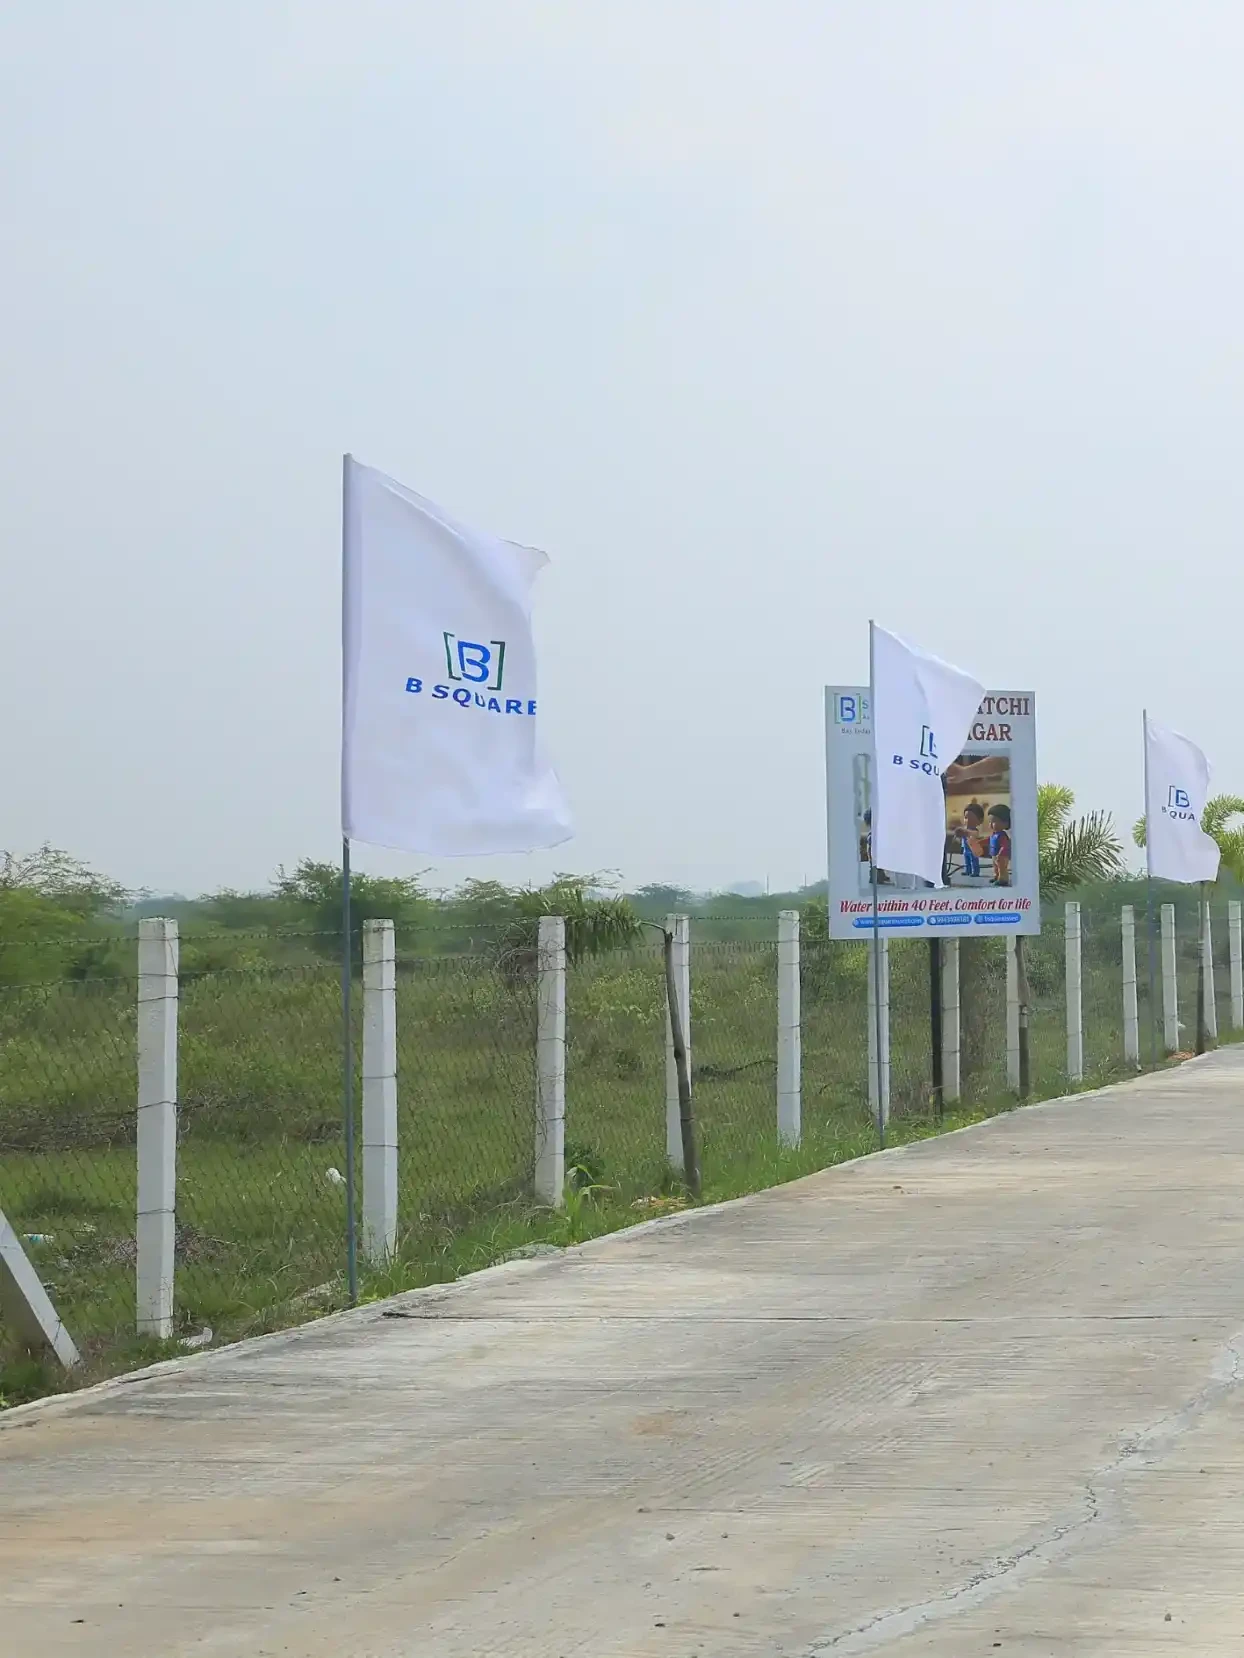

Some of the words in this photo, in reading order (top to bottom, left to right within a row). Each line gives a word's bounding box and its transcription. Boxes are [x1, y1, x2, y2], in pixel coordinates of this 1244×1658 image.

[405, 677, 423, 694] B
[431, 684, 537, 716] SQUARE
[967, 722, 1013, 742] GAR
[892, 754, 904, 766] B
[840, 900, 873, 913] Water
[911, 900, 927, 911] 40
[955, 898, 997, 911] Comfort
[998, 898, 1014, 910] for
[1015, 898, 1032, 910] life
